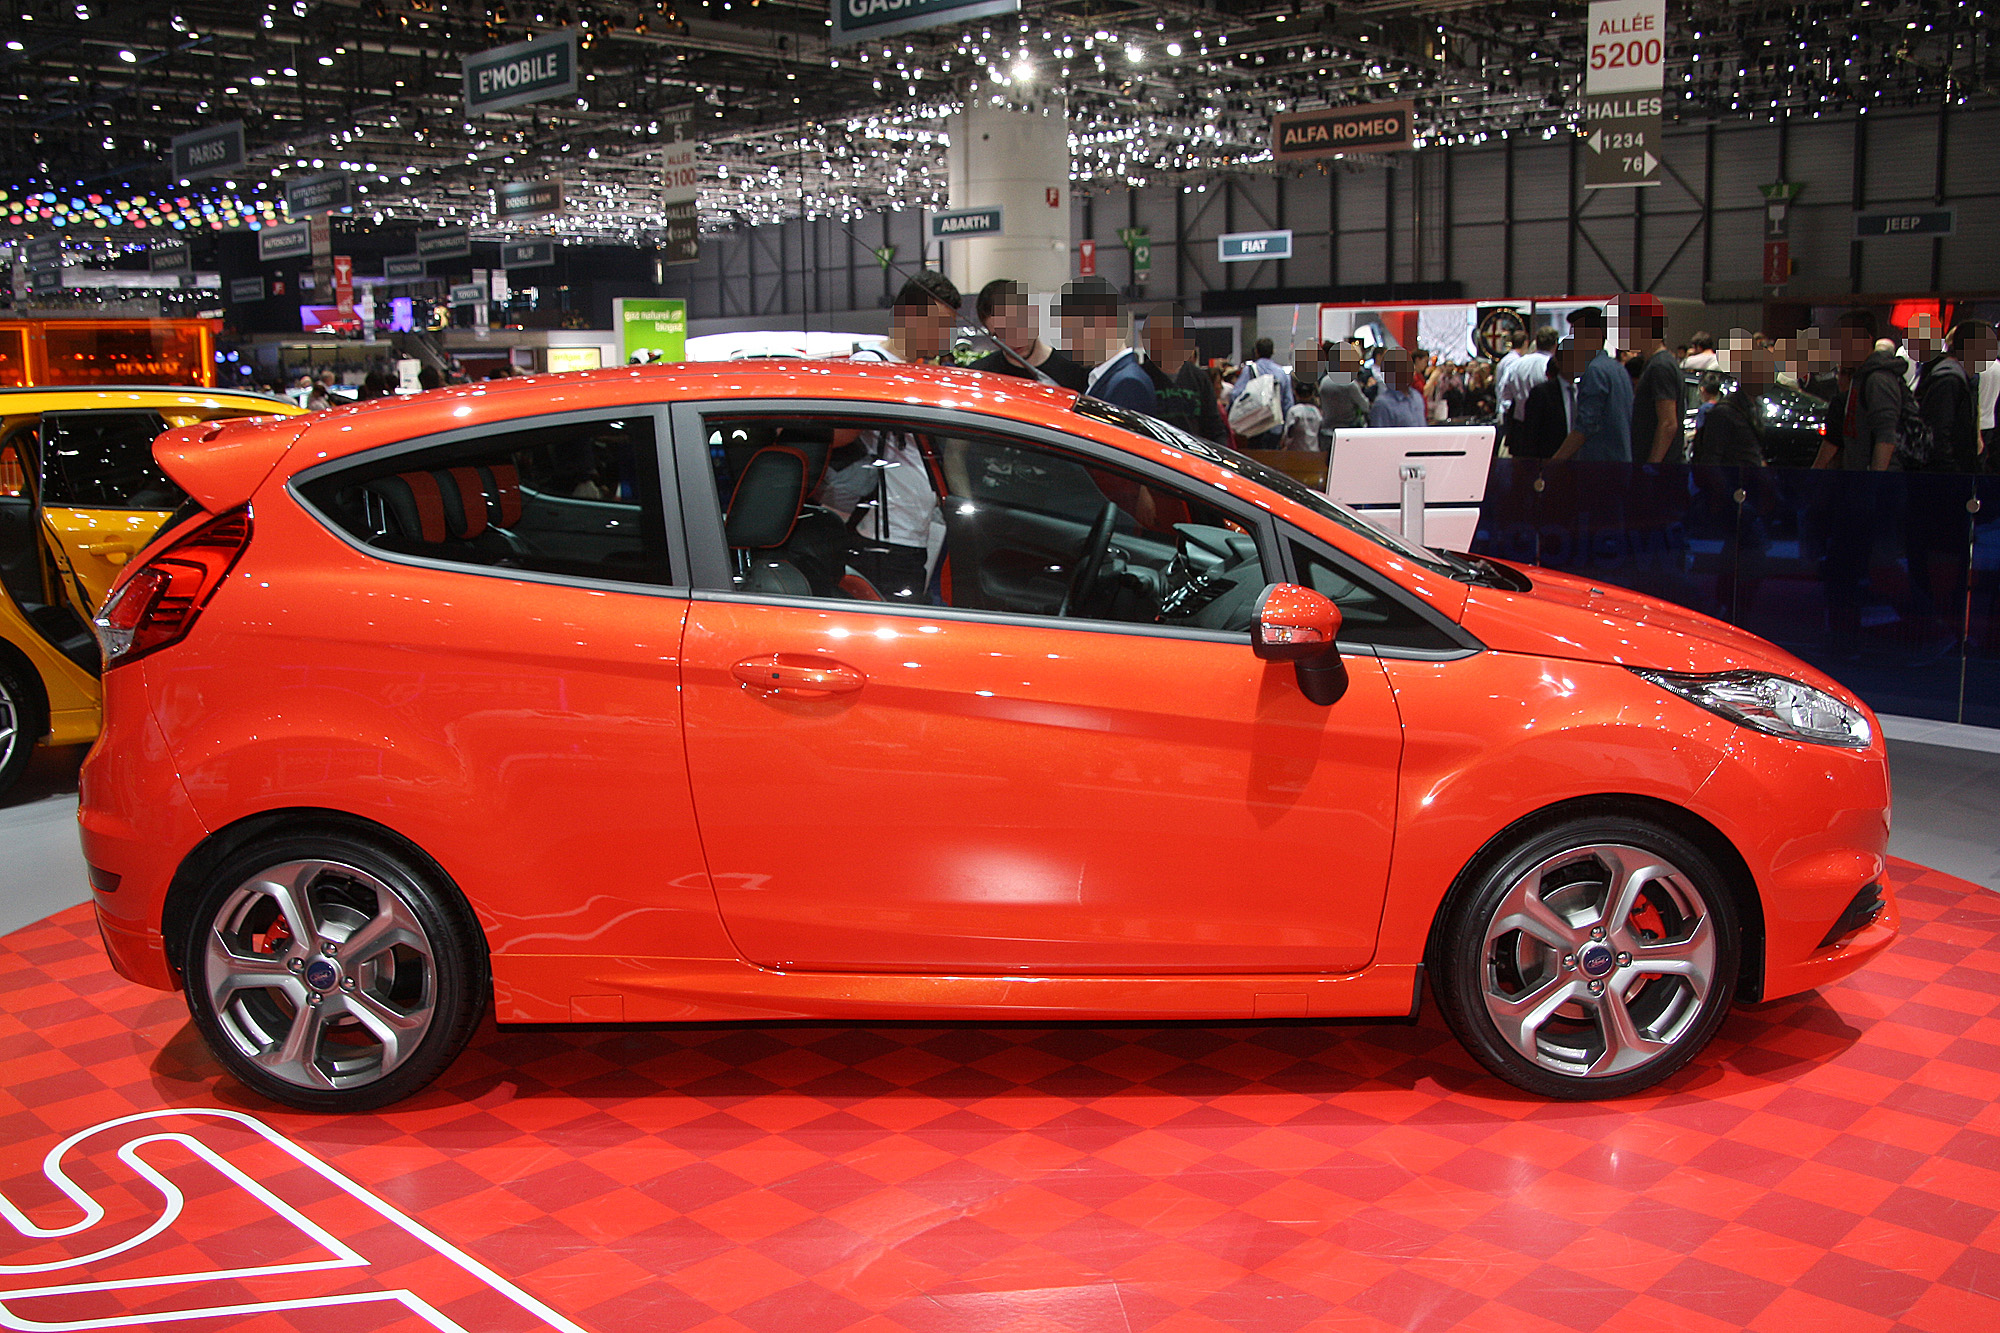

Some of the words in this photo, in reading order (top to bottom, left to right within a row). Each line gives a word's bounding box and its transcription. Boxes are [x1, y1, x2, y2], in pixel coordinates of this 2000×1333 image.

[1598, 12, 1655, 35] ALLÉE
[1590, 38, 1661, 70] 5200
[479, 53, 557, 94] E'MOBILE
[1587, 97, 1662, 120] HALLES
[1284, 124, 1329, 145] ALFA
[1333, 118, 1399, 140] ROMEO
[1603, 132, 1644, 149] 1234
[1622, 156, 1643, 172] 76
[665, 168, 696, 189] 5100
[941, 215, 990, 232] ABARTH
[1884, 216, 1920, 233] JEEP
[1241, 239, 1268, 253] FIAT
